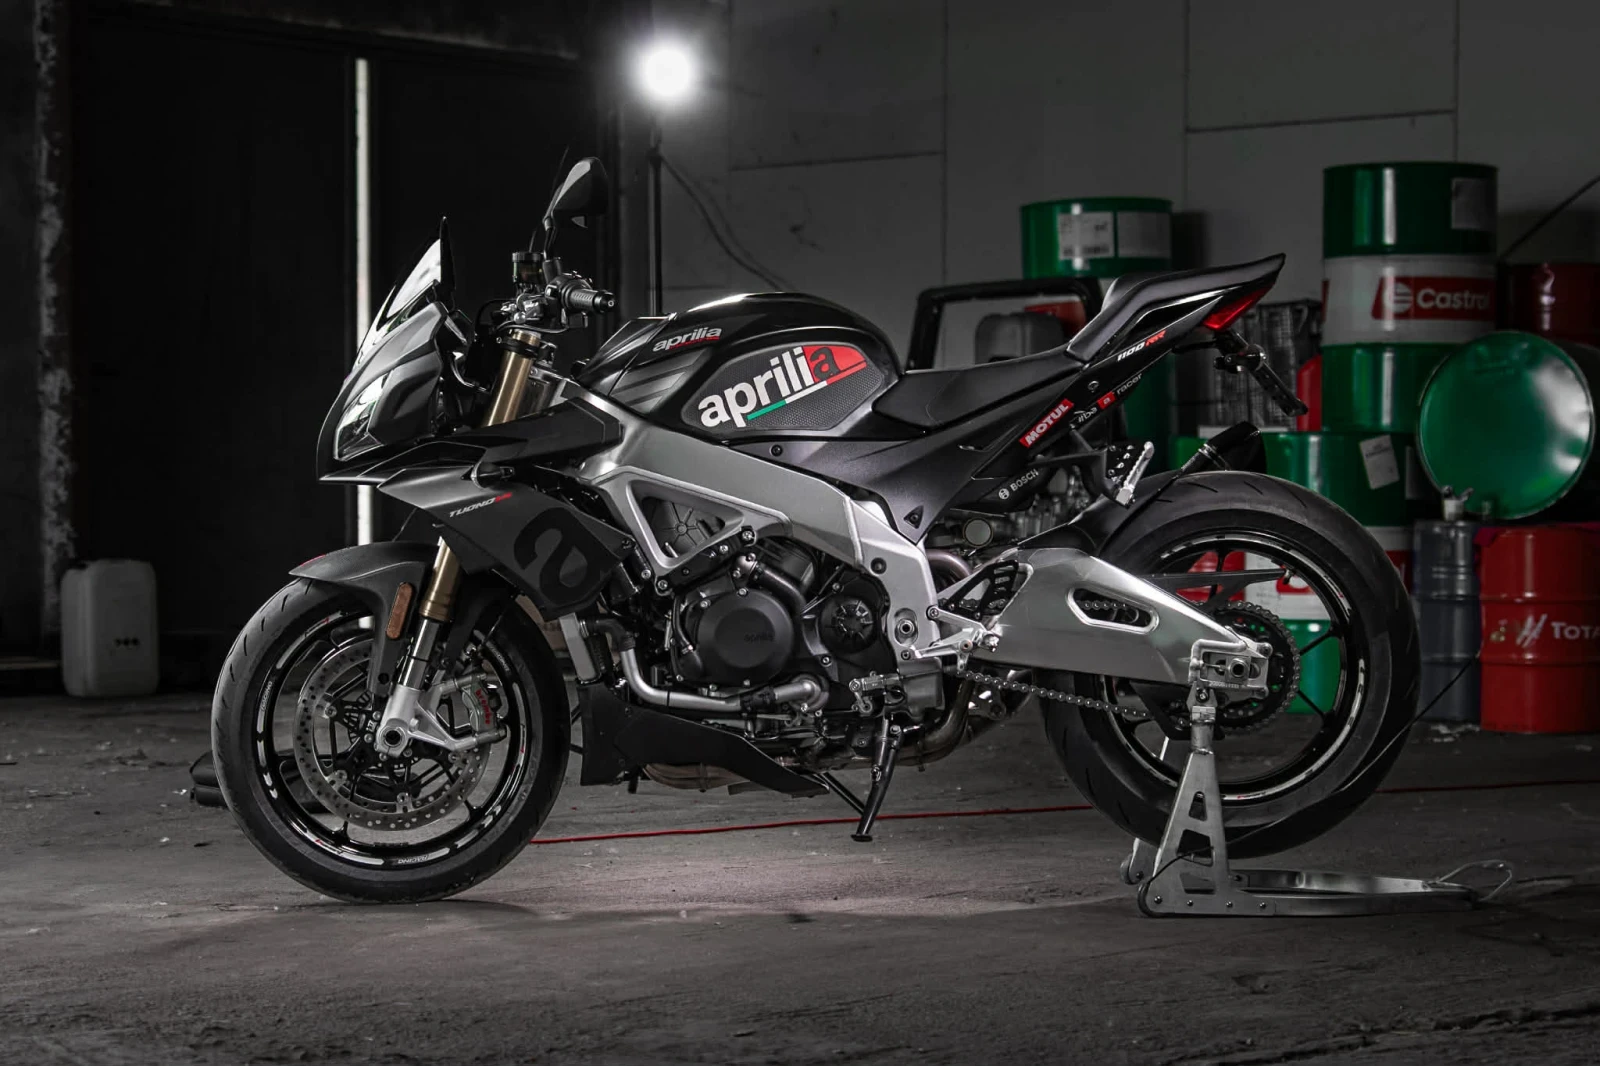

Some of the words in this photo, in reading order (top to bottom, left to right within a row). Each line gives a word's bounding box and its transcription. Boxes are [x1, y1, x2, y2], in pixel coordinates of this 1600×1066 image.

[652, 326, 722, 351] aprilia
[697, 346, 842, 428] aprilia
[1116, 374, 1142, 395] racer
[1025, 403, 1069, 445] MOTUL
[1009, 468, 1039, 492] BOSCH
